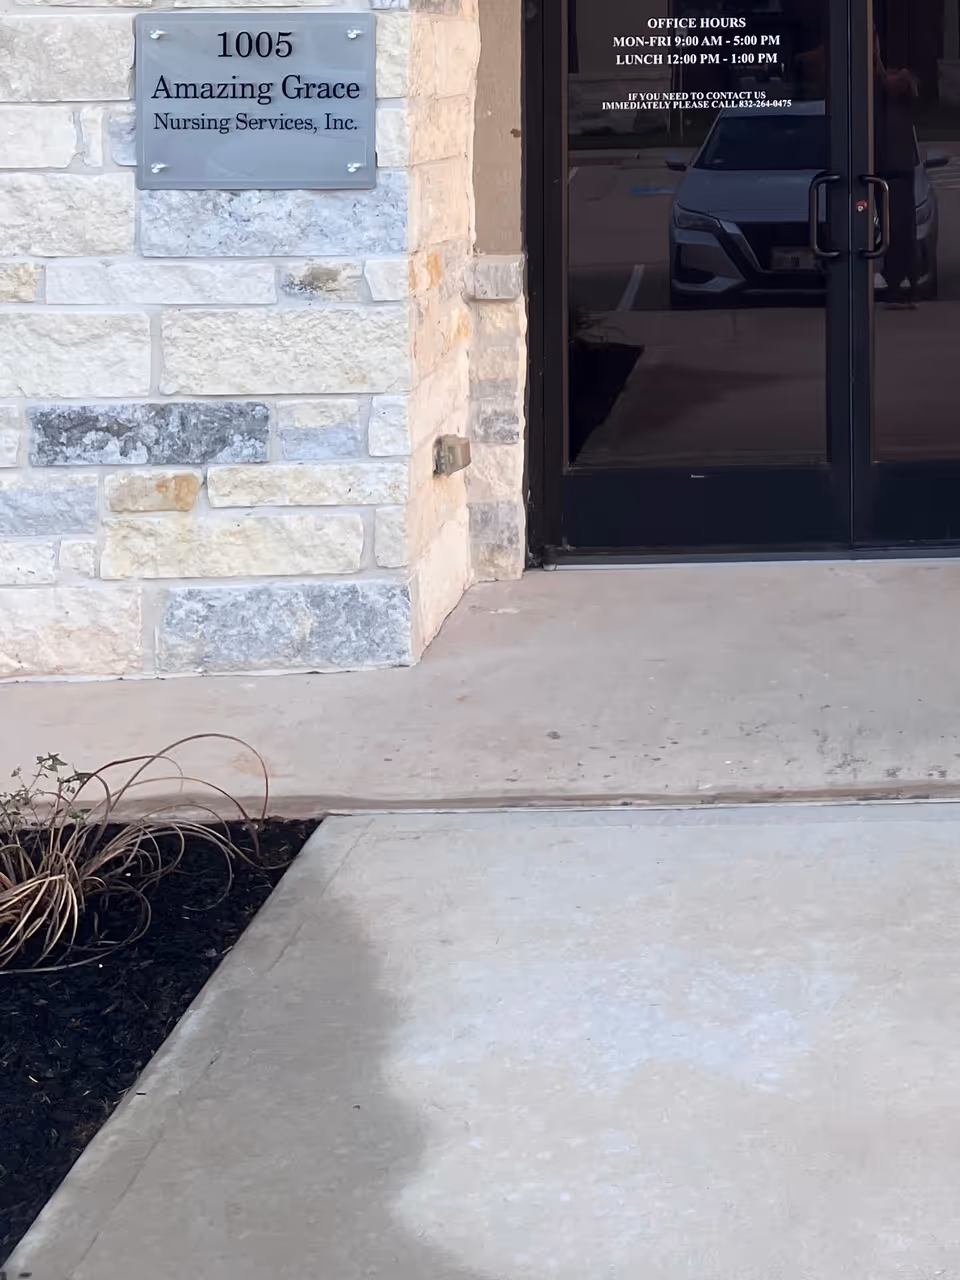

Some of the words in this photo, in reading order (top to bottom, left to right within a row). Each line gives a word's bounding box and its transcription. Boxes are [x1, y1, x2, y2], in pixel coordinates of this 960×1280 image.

[647, 18, 697, 29] OFFICE
[700, 17, 747, 28] HOURS
[217, 31, 293, 58] 1005
[613, 35, 672, 47] MON-FRI
[674, 35, 699, 47] 9:00
[701, 35, 723, 47] AM
[733, 35, 758, 46] 5:00
[760, 35, 780, 46] PM
[616, 54, 663, 66] LUNCH
[667, 54, 697, 65] 12:00
[700, 53, 720, 65] PM
[731, 53, 755, 64] 1:00
[758, 53, 778, 64] PM
[151, 74, 274, 106] Amazing
[281, 74, 361, 100] Grace
[628, 93, 639, 101] IF
[640, 93, 660, 101] YOU
[662, 92, 689, 101] NEED
[690, 92, 704, 100] TO
[706, 92, 753, 100] CONTACT
[754, 91, 766, 100] US
[602, 101, 671, 110] IMMEDIATELY
[673, 101, 709, 109] PLEASE
[711, 100, 738, 108] CALL
[738, 100, 792, 108] 832-264-0475
[153, 112, 231, 134] Nursing
[235, 112, 318, 134] Services,
[324, 112, 358, 131] Inc.
